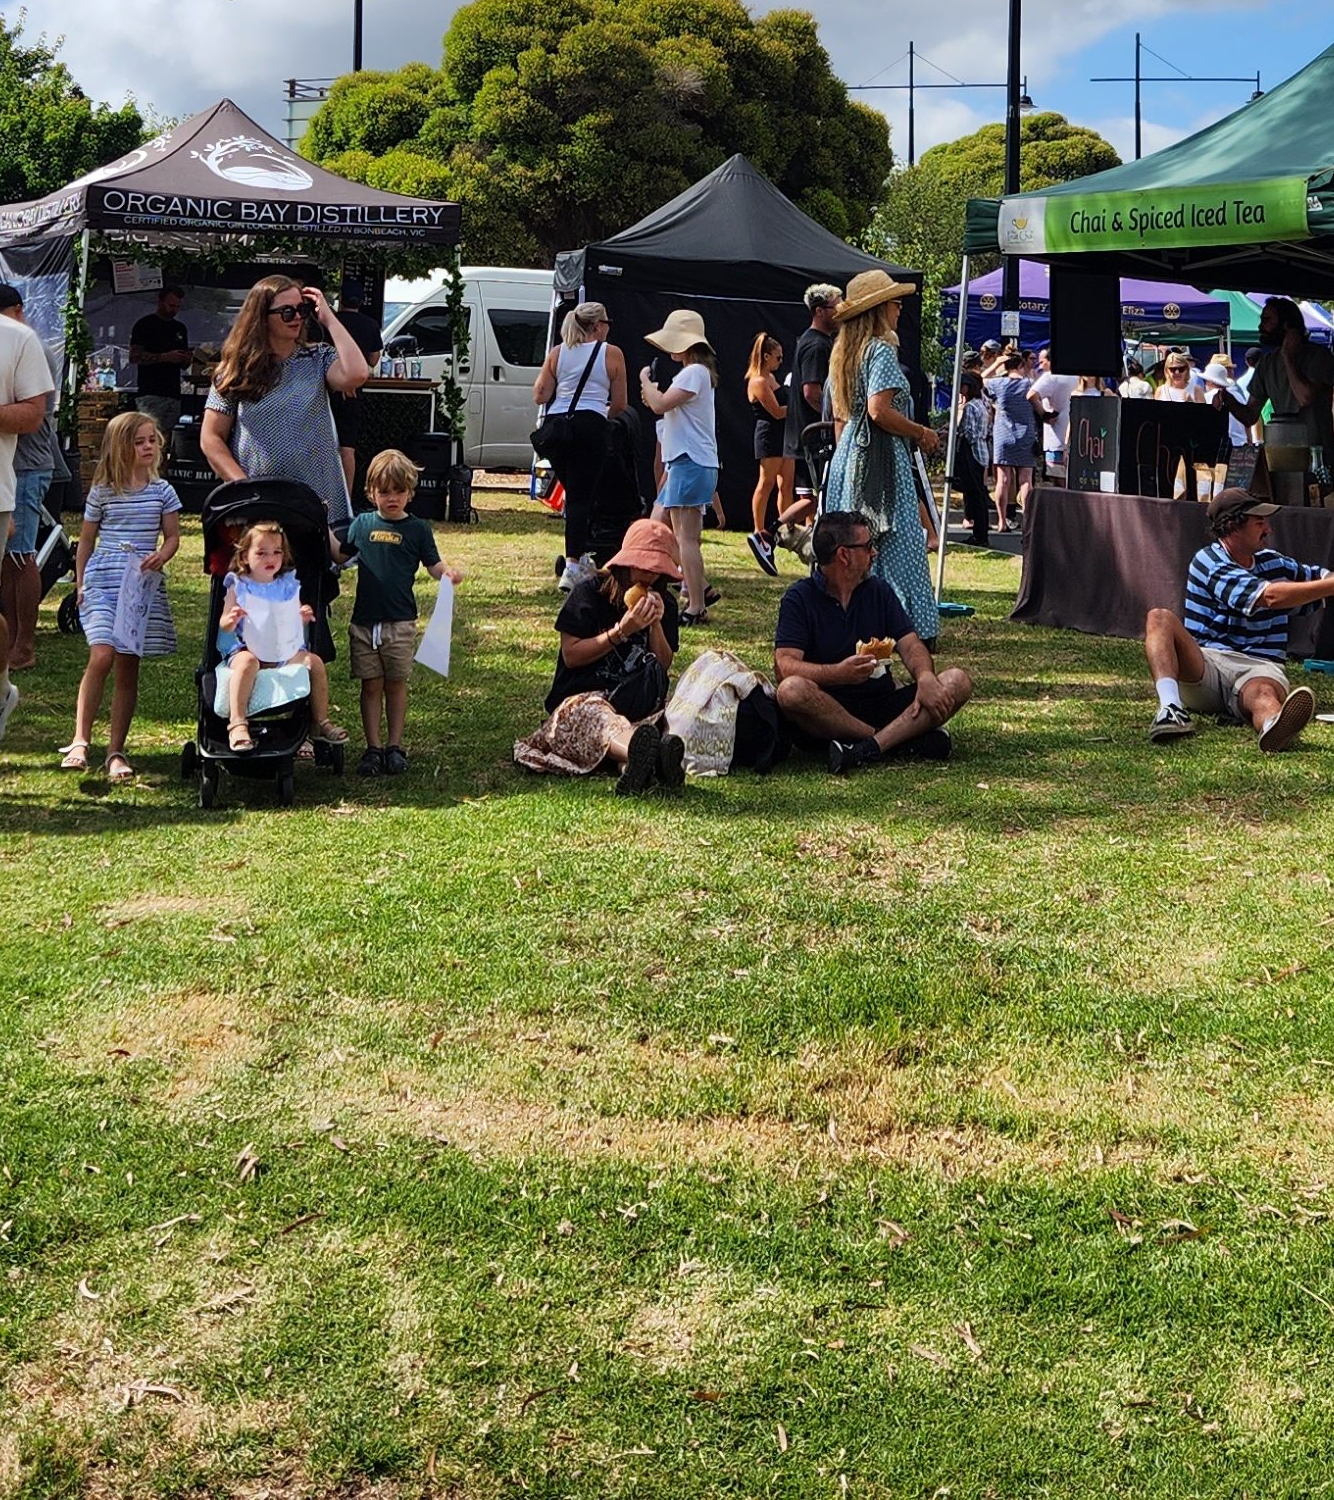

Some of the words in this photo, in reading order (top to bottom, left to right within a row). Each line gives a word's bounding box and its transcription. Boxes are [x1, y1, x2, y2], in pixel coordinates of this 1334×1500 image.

[103, 190, 233, 219] ORGANIC
[240, 201, 291, 223] BAY
[296, 204, 445, 225] DISTILLERY
[1069, 209, 1107, 235] Chai
[1111, 211, 1124, 231] &
[1128, 203, 1185, 237] Spiced
[1191, 201, 1228, 228] Iced
[1233, 199, 1266, 225] Tea
[123, 215, 178, 227] CERTIFIED
[178, 218, 226, 229] ORGANIC
[292, 224, 342, 234] DISTILLED
[342, 226, 352, 234] IN
[410, 228, 426, 238] VIC
[1122, 305, 1145, 317] Eliza
[1078, 418, 1108, 464] Chai
